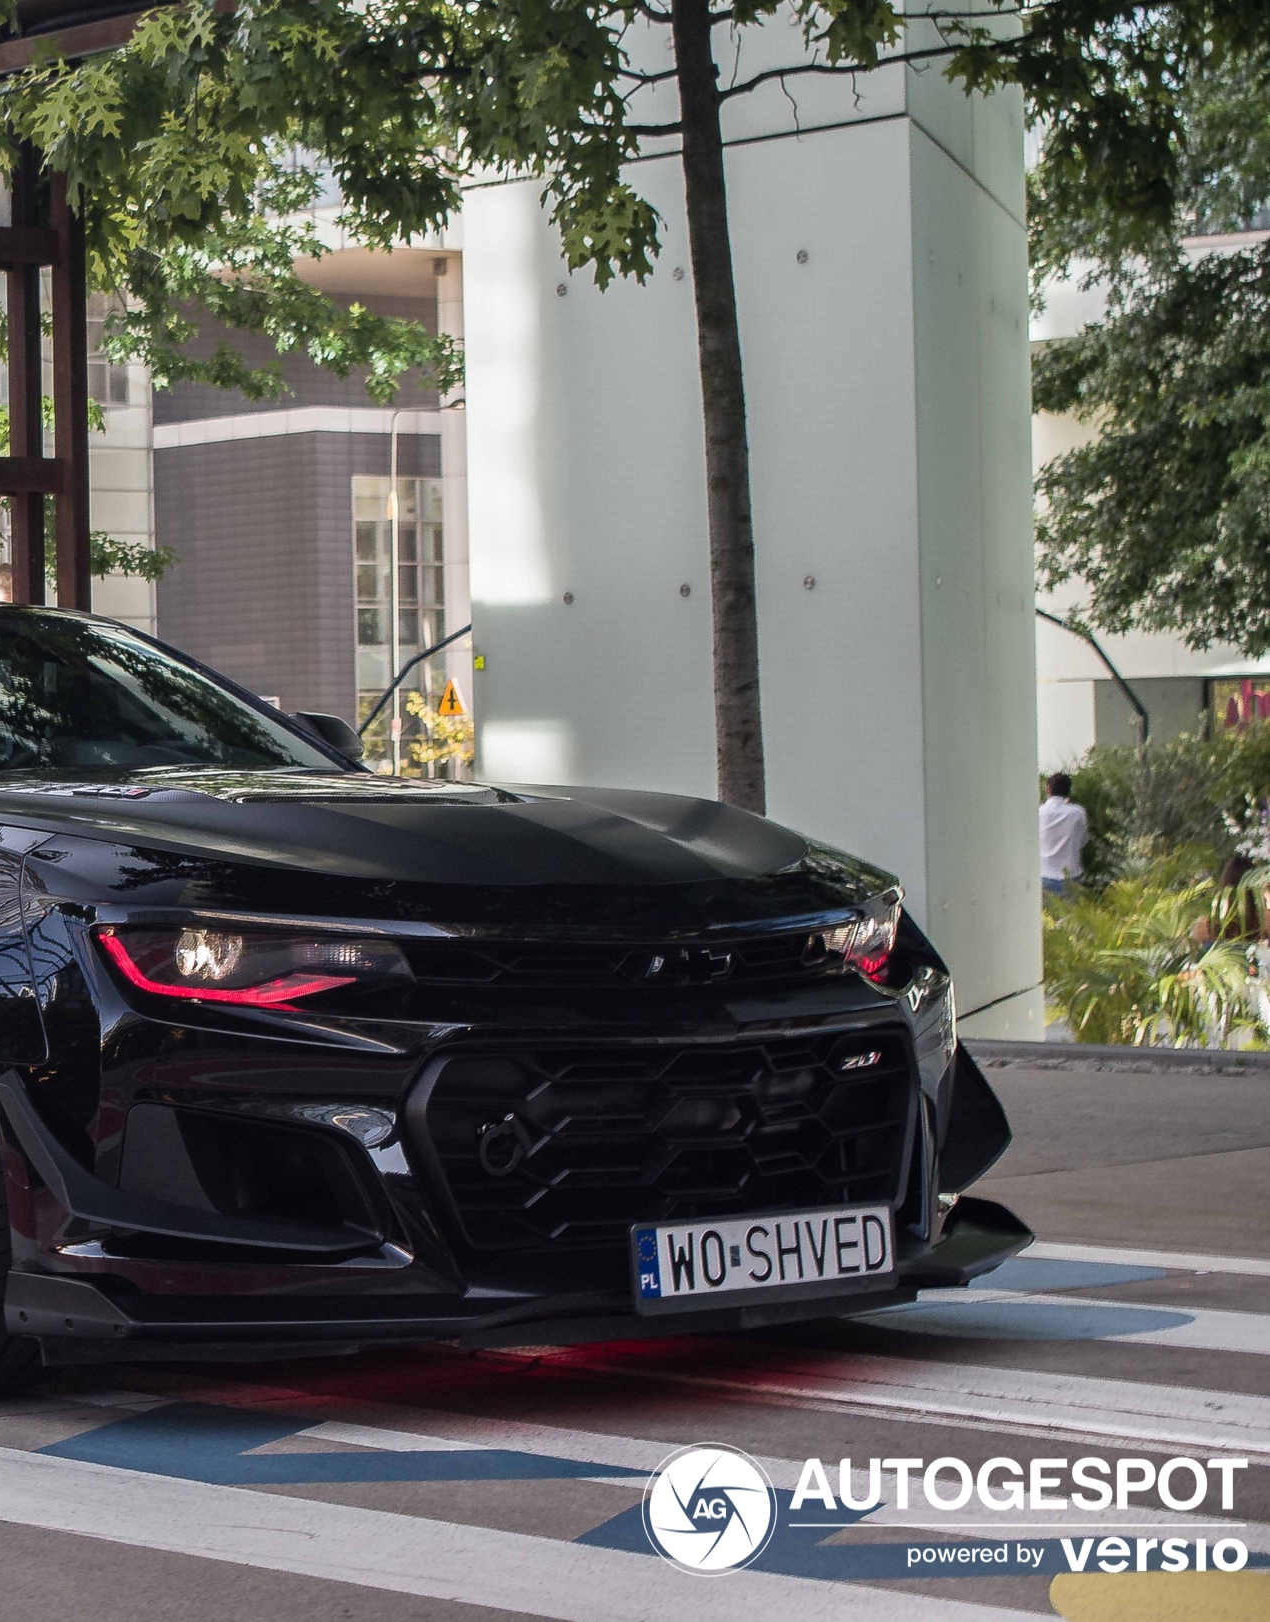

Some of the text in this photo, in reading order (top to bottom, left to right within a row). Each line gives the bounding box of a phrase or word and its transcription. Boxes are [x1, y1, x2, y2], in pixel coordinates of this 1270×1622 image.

[667, 1215, 887, 1292] WO SHVED
[641, 1272, 658, 1290] PL
